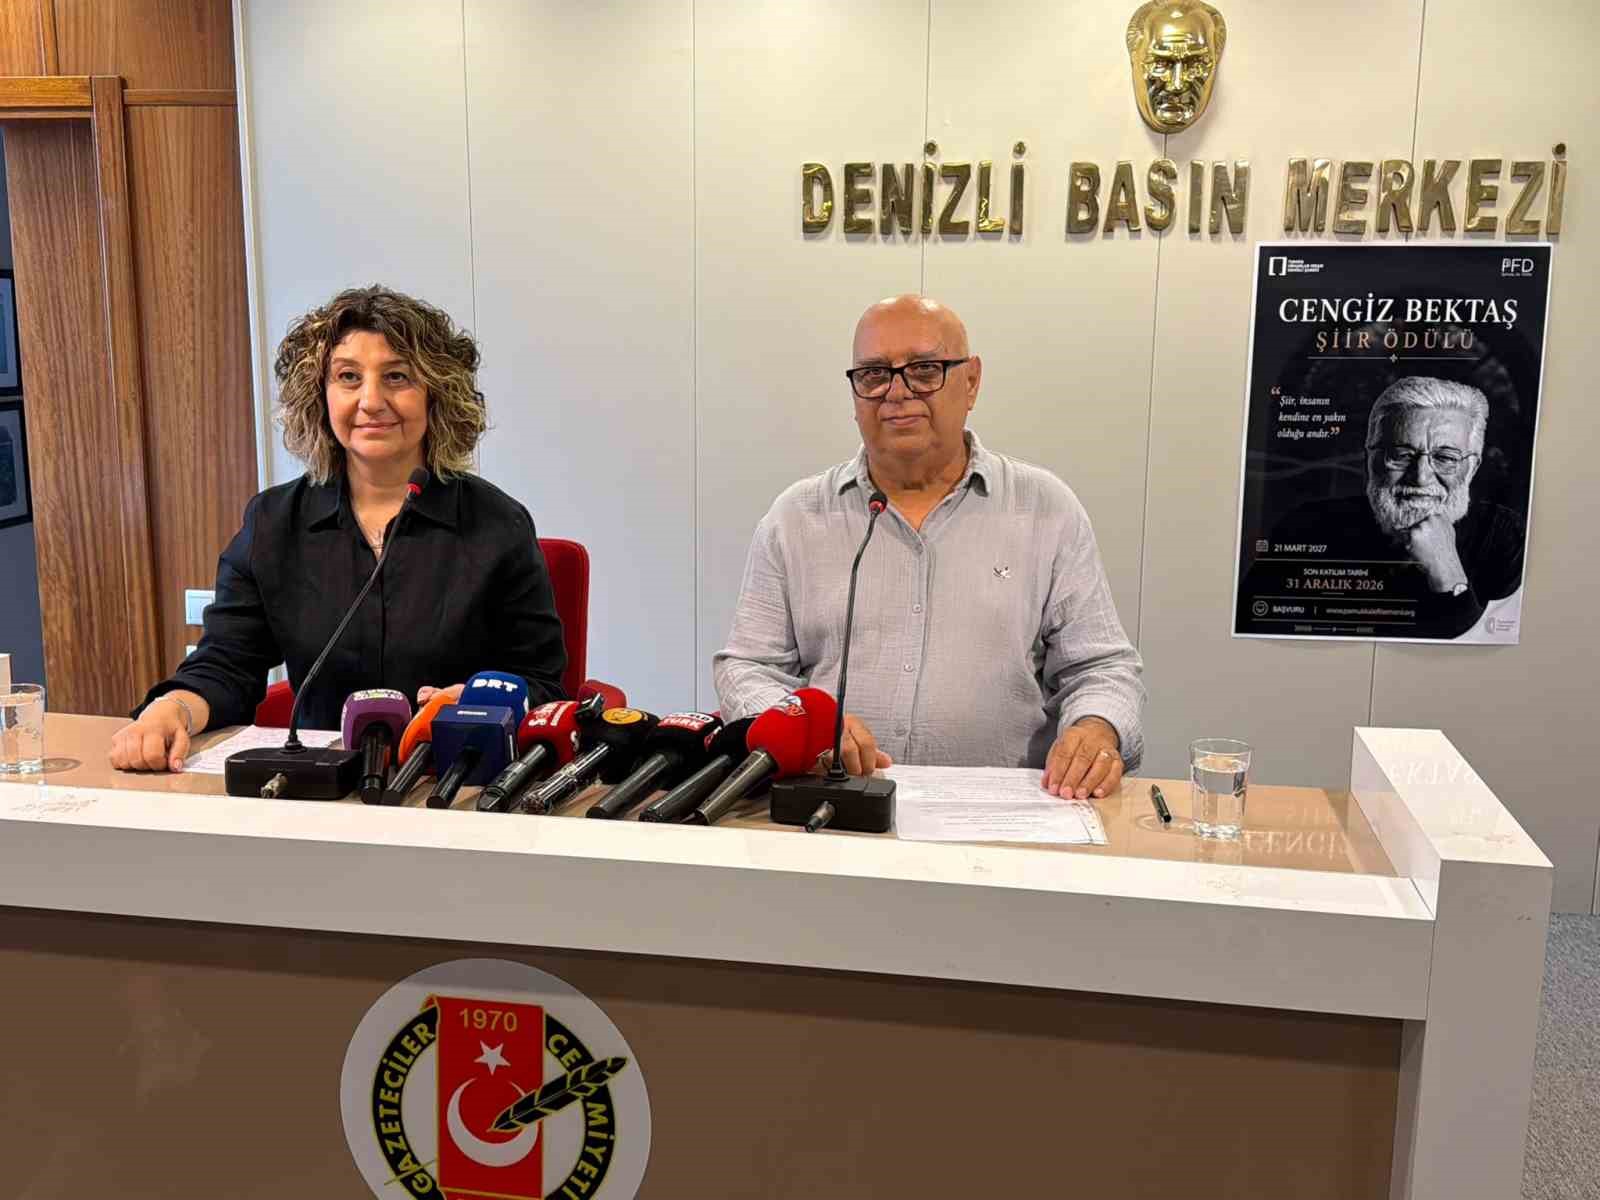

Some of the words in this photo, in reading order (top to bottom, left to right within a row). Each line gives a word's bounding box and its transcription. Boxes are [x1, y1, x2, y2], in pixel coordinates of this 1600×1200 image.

[802, 141, 1025, 235] DENİZLİ
[1067, 159, 1250, 235] BASIN
[1284, 143, 1567, 235] MERKEZİ
[1501, 257, 1535, 273] PFD
[1279, 292, 1394, 323] CENGİZ
[1405, 298, 1518, 330] BEKTAŞ
[1316, 328, 1371, 353] ŞİİR
[1383, 328, 1475, 350] ÖDÜLÜ
[1274, 544, 1283, 552] 21
[1284, 544, 1307, 553] MART
[1308, 544, 1328, 553] 2027
[1286, 578, 1300, 589] 31
[1303, 578, 1353, 591] ARALIK
[1356, 579, 1385, 592] 2026
[459, 1008, 518, 1033] 1970
[379, 1022, 436, 1193] GAZETECİLER
